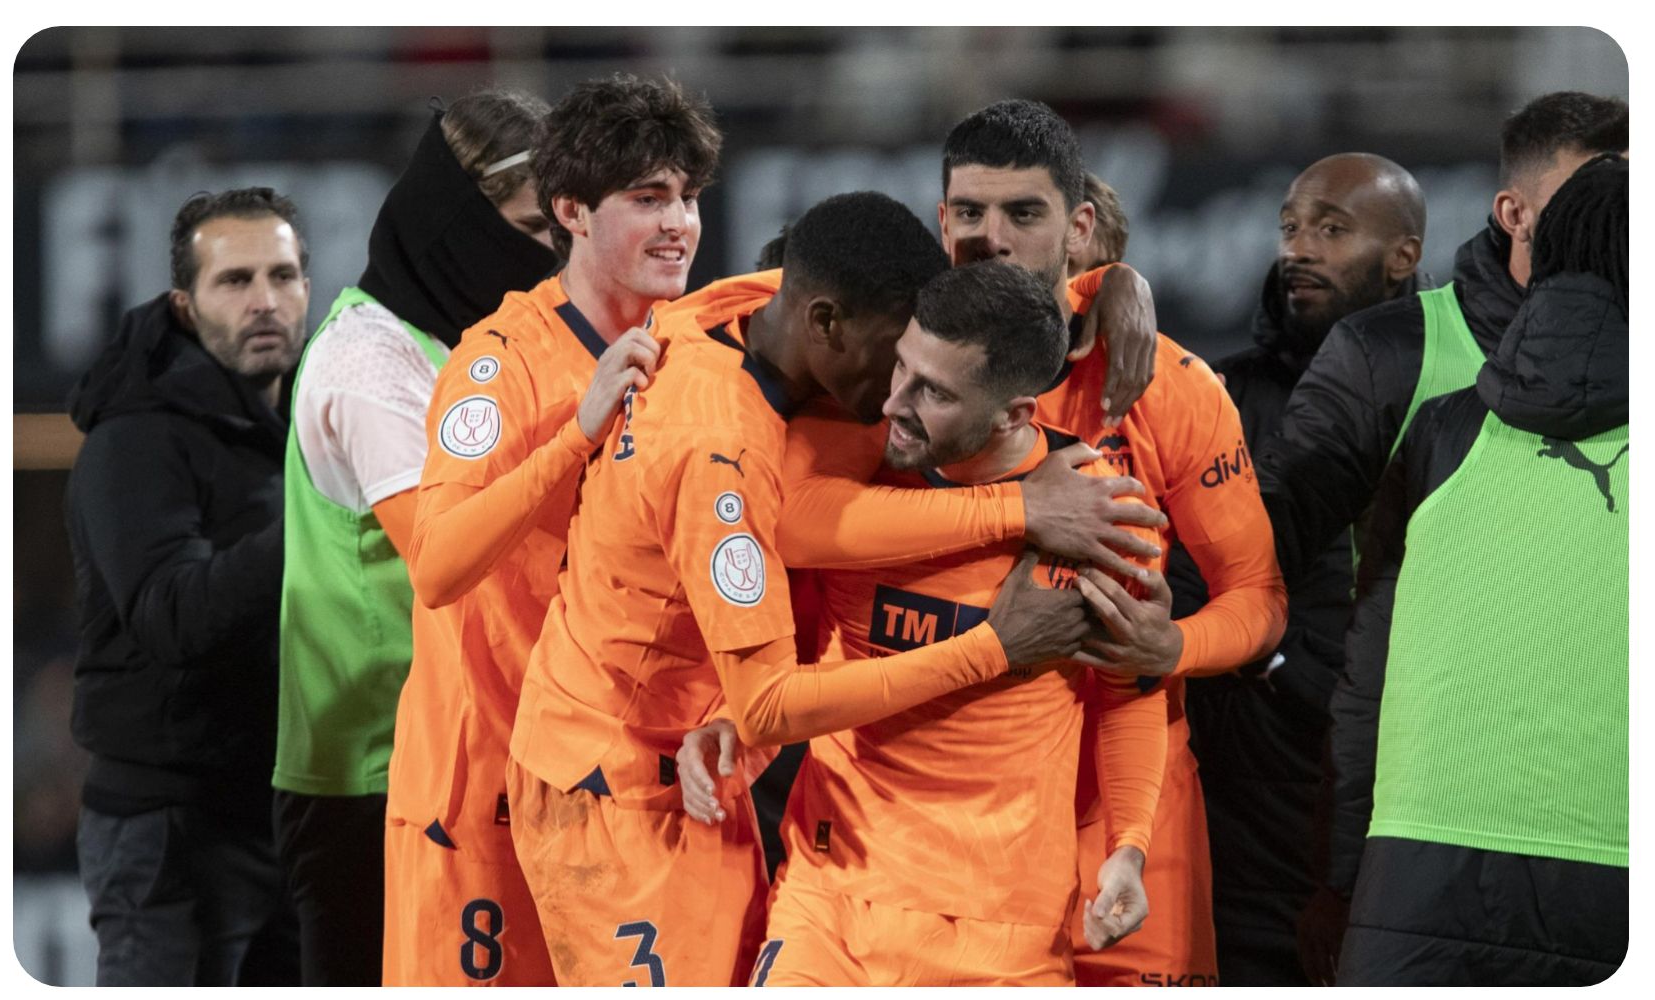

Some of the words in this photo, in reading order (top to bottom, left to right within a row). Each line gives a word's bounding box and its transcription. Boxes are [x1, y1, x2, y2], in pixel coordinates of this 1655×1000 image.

[479, 364, 490, 374] 8
[1200, 439, 1249, 488] divi
[725, 503, 735, 513] 8
[882, 603, 938, 644] TM
[460, 898, 504, 981] 8
